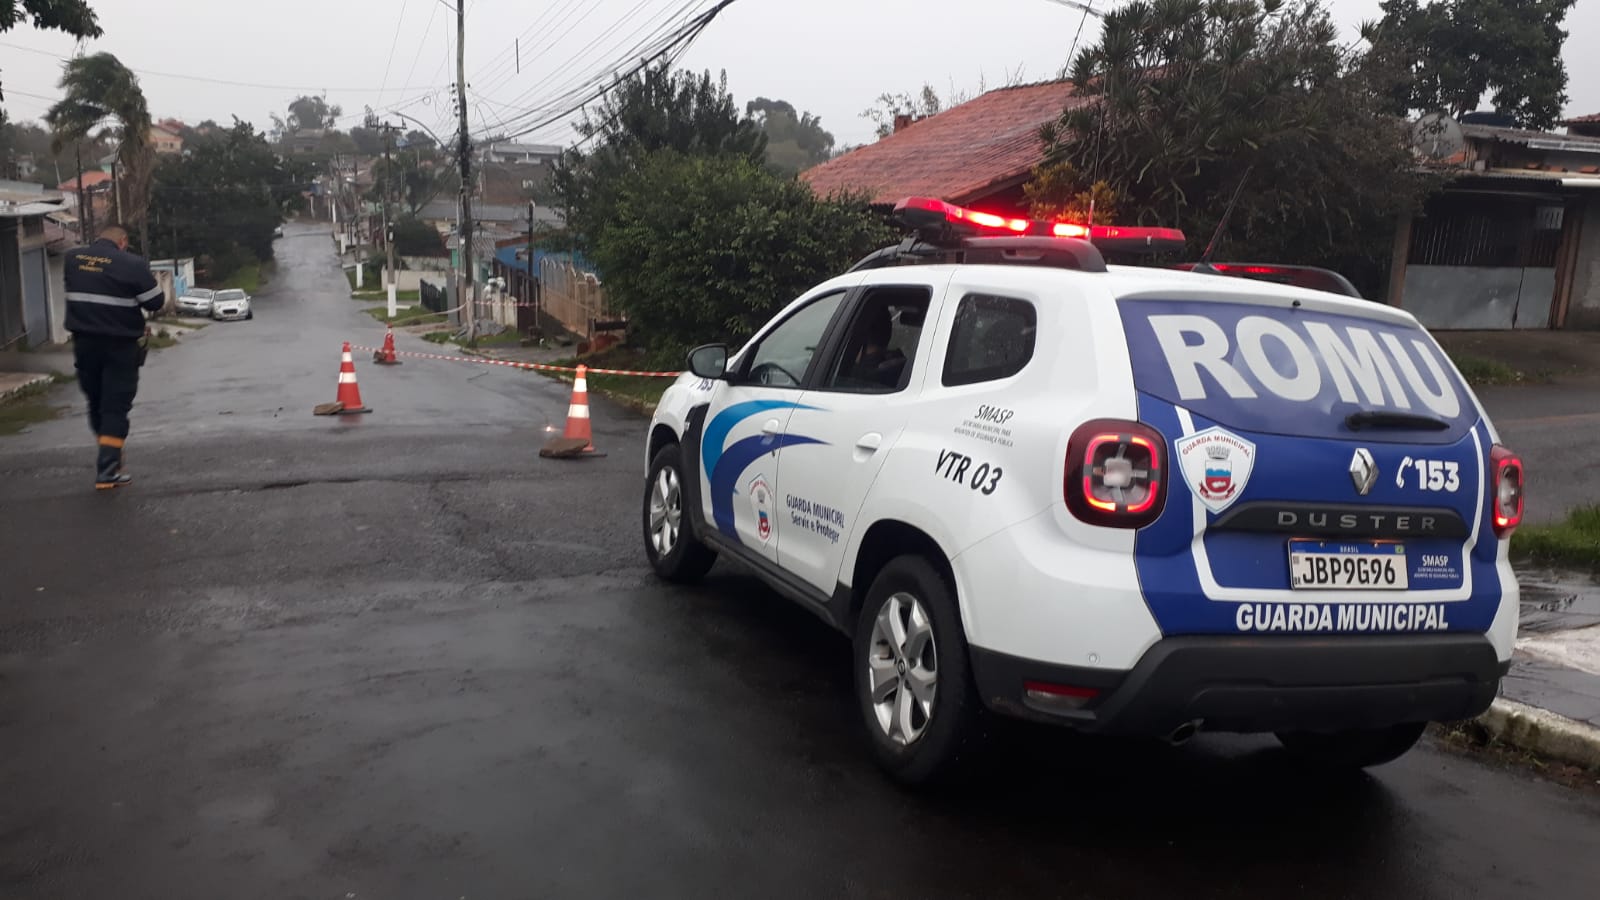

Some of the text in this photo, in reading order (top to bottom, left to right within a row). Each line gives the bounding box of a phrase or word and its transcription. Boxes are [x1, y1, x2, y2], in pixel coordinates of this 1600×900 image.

[1147, 314, 1461, 418] ROMU
[974, 404, 1014, 424] SMASP
[1182, 435, 1250, 457] GUARDA MUNICIPAL
[935, 448, 1003, 495] VTR 03
[1414, 459, 1460, 492] 153
[786, 494, 845, 528] GUARDA MUNICIPAL
[1278, 511, 1435, 530] DUSTER
[791, 511, 840, 544] Servir e Proteger
[1340, 545, 1359, 553] BRASIL
[1422, 554, 1449, 568] SMASP
[1303, 557, 1396, 585] JBP9G96
[1236, 603, 1448, 631] GUARDA MUNICIPAL
